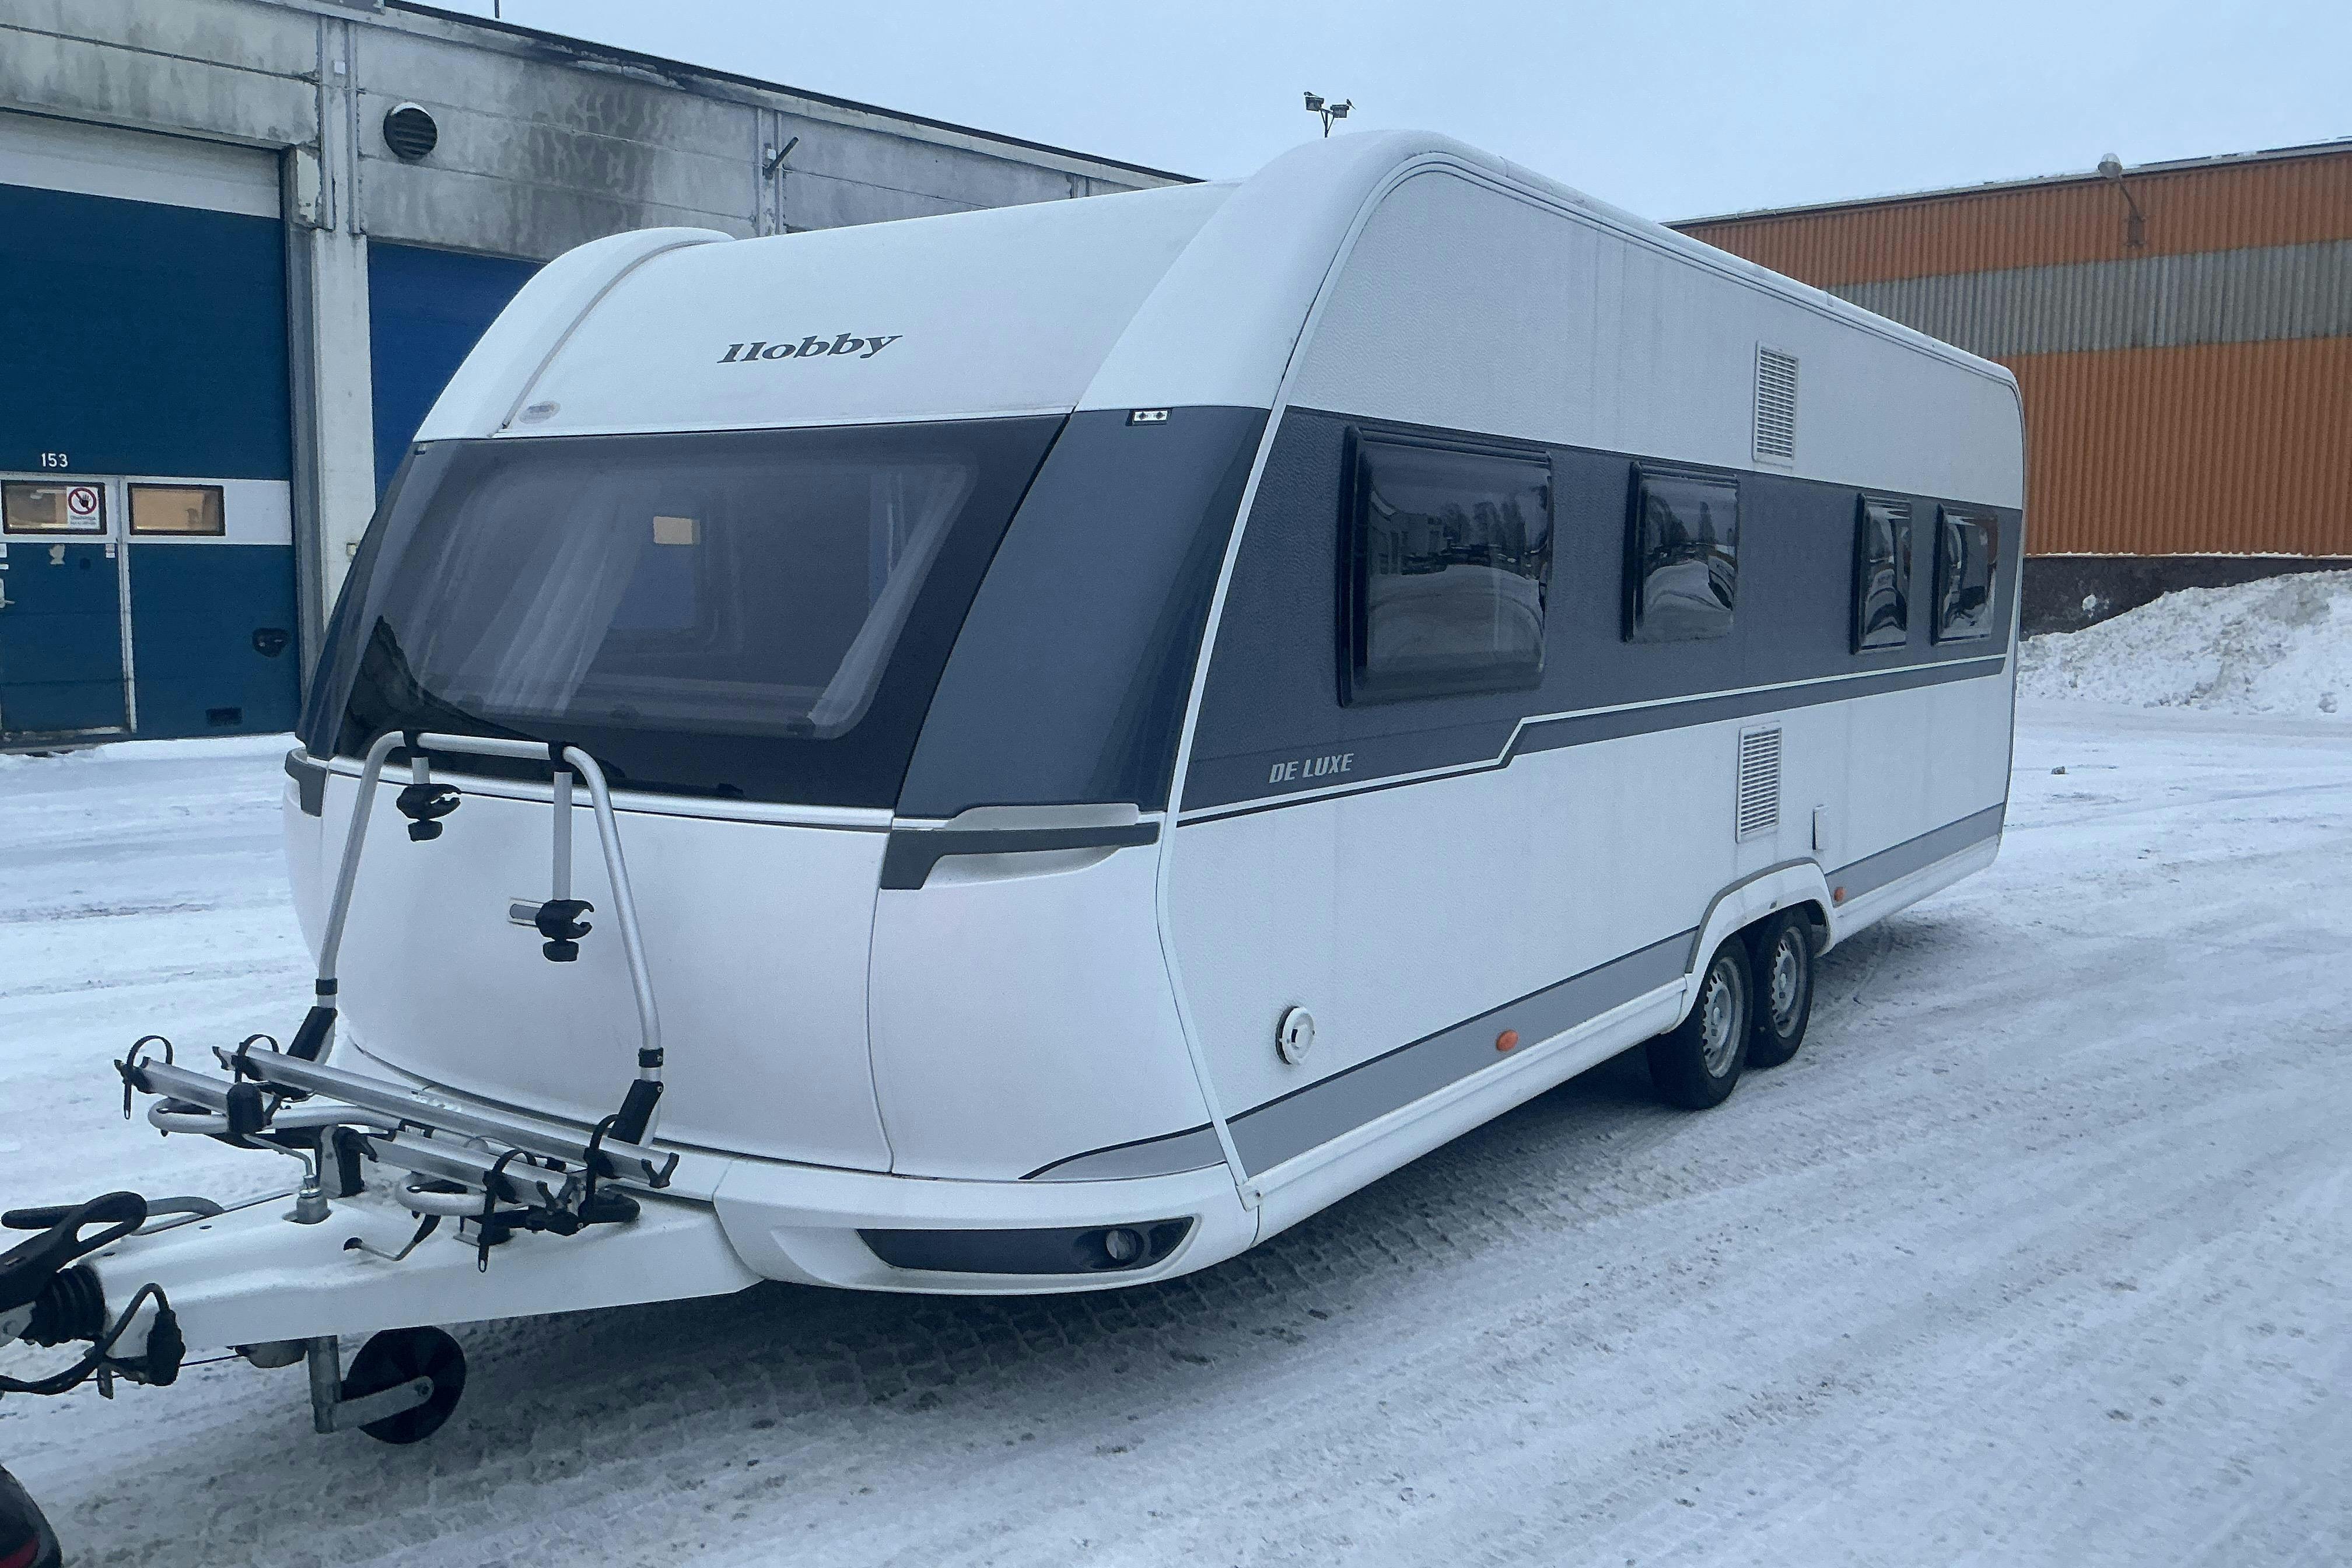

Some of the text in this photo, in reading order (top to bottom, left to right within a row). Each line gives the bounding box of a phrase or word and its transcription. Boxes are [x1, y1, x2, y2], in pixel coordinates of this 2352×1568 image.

[716, 332, 903, 363] Hobby
[41, 453, 68, 467] 153
[1269, 752, 1354, 783] DE LUXE
